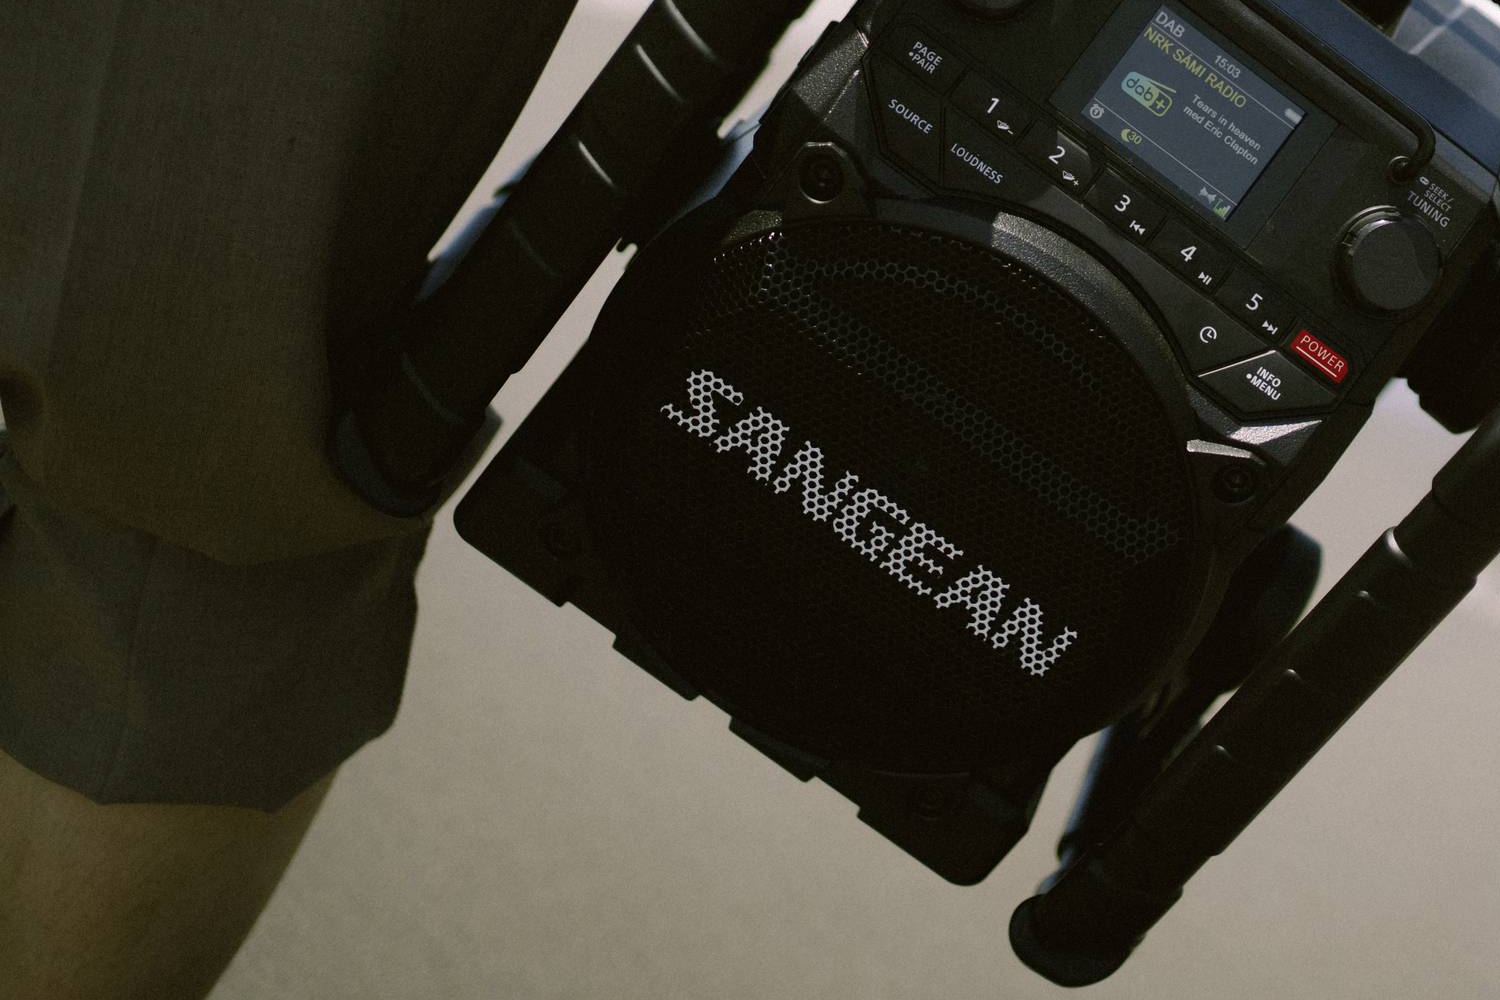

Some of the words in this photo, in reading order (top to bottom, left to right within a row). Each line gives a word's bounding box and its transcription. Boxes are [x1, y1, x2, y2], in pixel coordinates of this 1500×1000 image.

[1155, 11, 1185, 37] DAB
[913, 41, 943, 66] PAGE
[1143, 26, 1174, 54] NRK
[1172, 48, 1206, 77] SÁMI
[1205, 73, 1247, 108] RADIO
[1214, 55, 1241, 78] 15:03
[888, 99, 934, 135] SOURCE
[987, 97, 1000, 114] 1
[1192, 94, 1218, 118] Tears
[1218, 114, 1228, 126] in
[1228, 122, 1261, 151] heaven
[1127, 131, 1142, 145] 30
[1183, 106, 1205, 124] med
[1203, 120, 1223, 138] Eric
[1223, 135, 1258, 165] Clapton
[951, 143, 1004, 184] LOUDNESS
[1048, 145, 1066, 165] 2
[1114, 194, 1131, 212] 3
[1408, 190, 1451, 228] TUNING
[1423, 189, 1452, 212] SELECT
[1180, 246, 1197, 262] 4
[1245, 293, 1263, 311] 5
[1300, 335, 1345, 373] POWER
[1256, 366, 1282, 388] INFO
[661, 370, 1078, 677] SANGEAN
